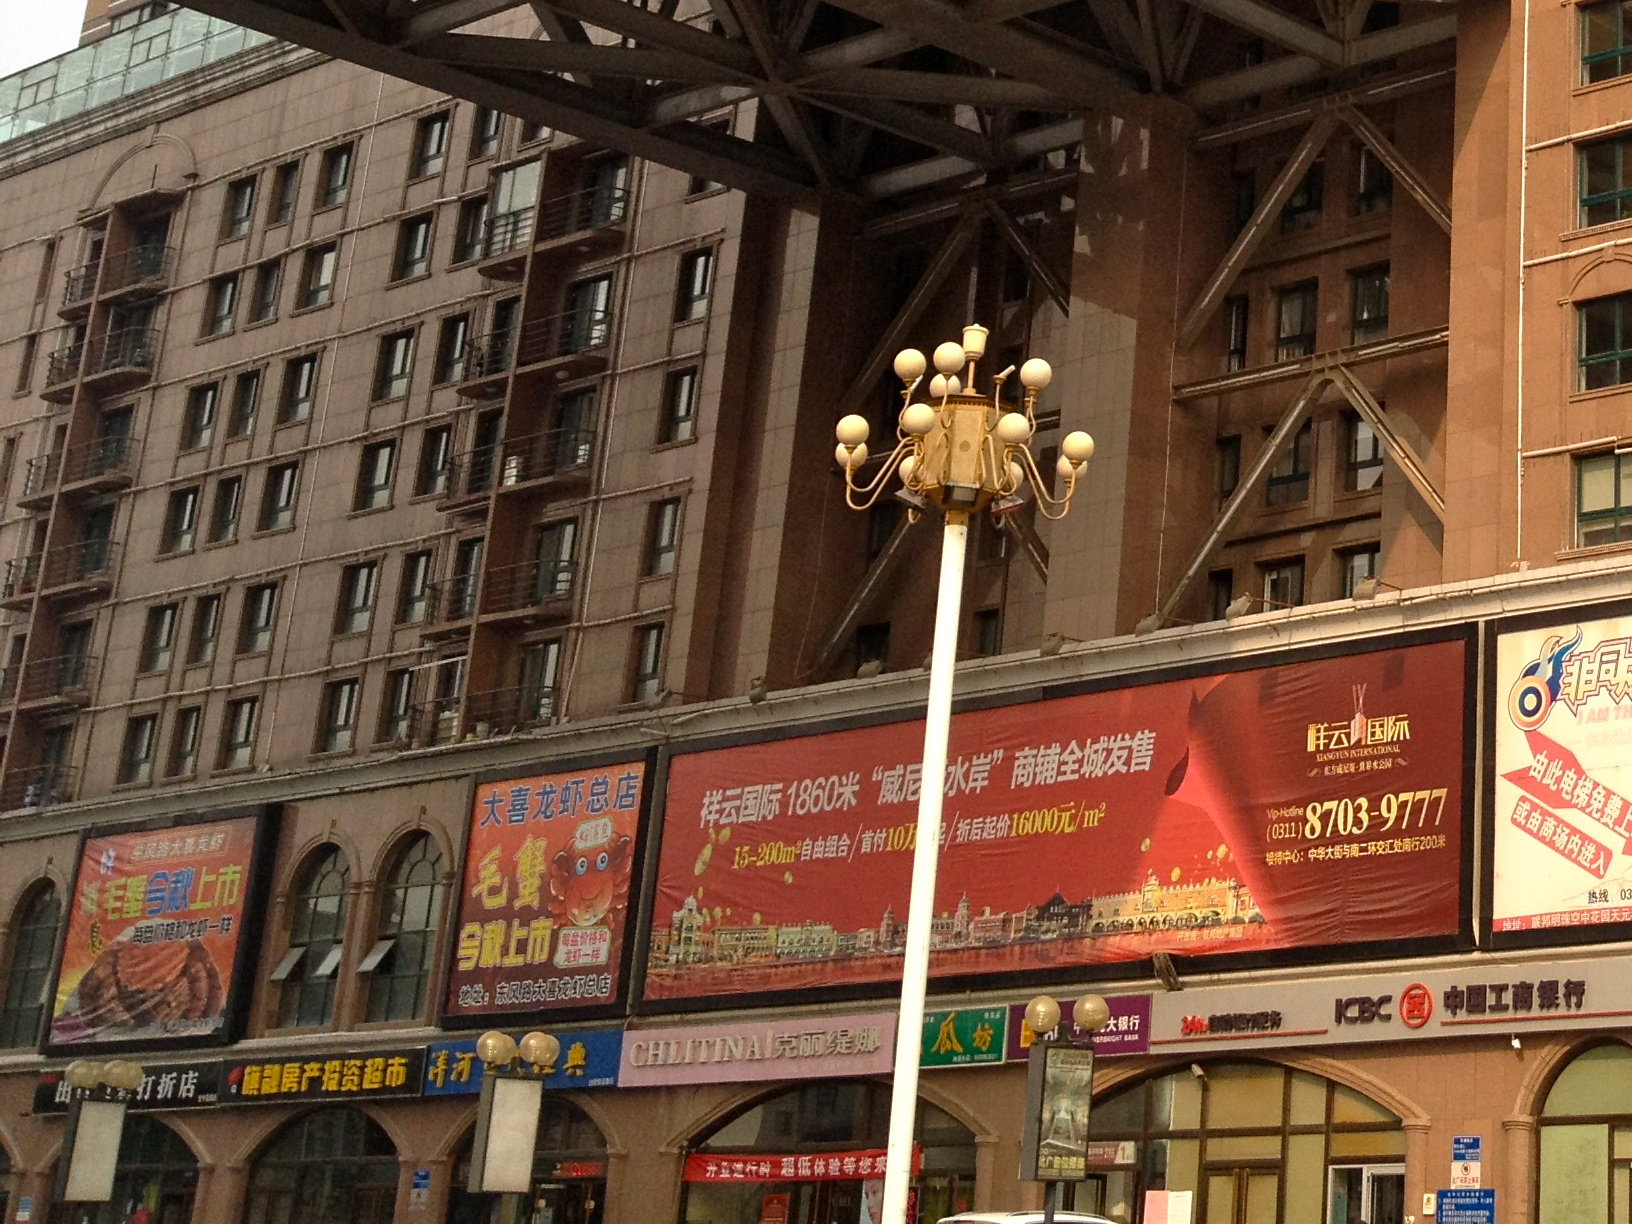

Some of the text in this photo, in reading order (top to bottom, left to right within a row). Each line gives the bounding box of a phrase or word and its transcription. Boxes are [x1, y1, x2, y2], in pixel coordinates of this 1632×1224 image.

[1306, 714, 1411, 753] 祥云国际
[480, 771, 642, 828] 大喜龙虾总店
[700, 729, 1157, 829] 祥云国际 1860米 “威尼水岸” 商铺全城发售
[1304, 788, 1448, 840] 8703-9777
[1512, 799, 1606, 876] 或由商场内进入
[472, 834, 548, 910] 毛蟹
[1587, 889, 1610, 905] 热线
[458, 917, 554, 971] 今秋上市
[1334, 993, 1393, 1026] ICBC
[1443, 978, 1587, 1017] 中国工商银行
[629, 1032, 764, 1067] CHLITINA
[775, 1026, 881, 1059] 克丽缇娜
